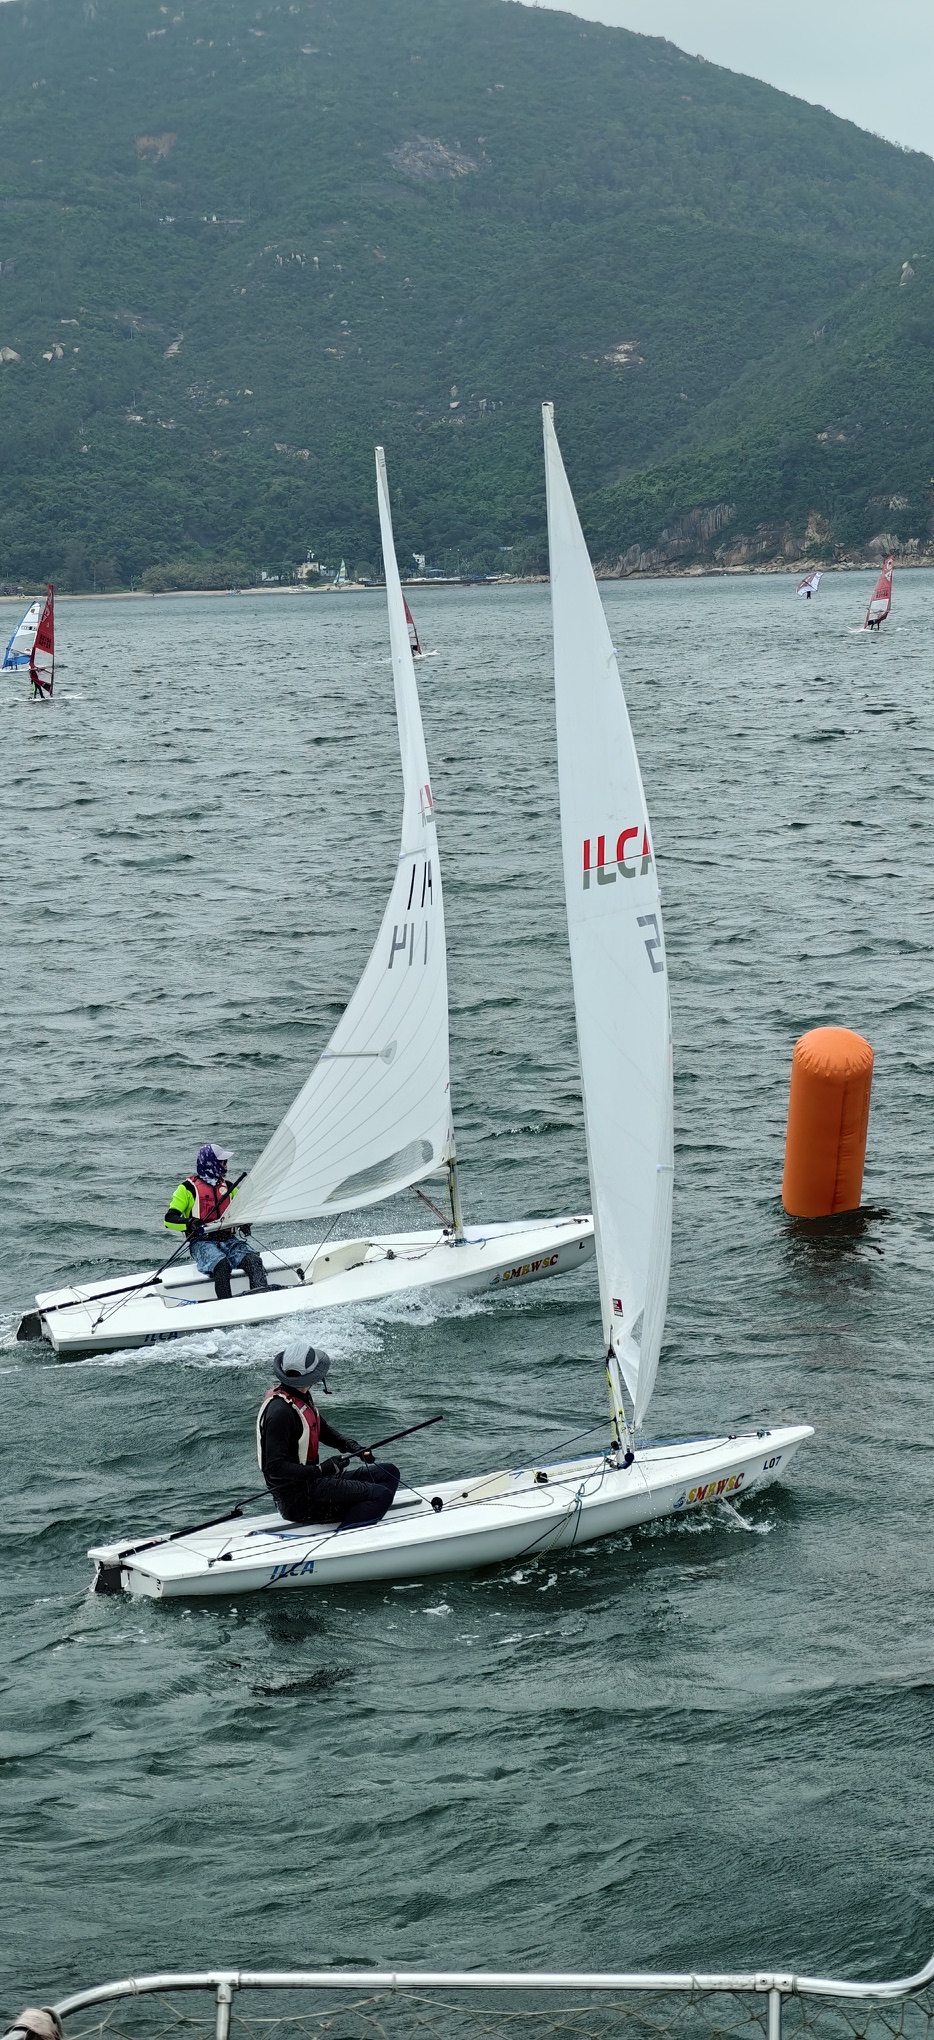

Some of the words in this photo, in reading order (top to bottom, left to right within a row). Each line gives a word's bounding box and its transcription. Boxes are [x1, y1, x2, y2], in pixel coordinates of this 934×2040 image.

[502, 1254, 558, 1281] SMBWSC
[144, 1332, 178, 1342] ILCA
[763, 1455, 782, 1470] L07
[686, 1472, 744, 1504] SMBWSC
[270, 1561, 315, 1580] ILCA
